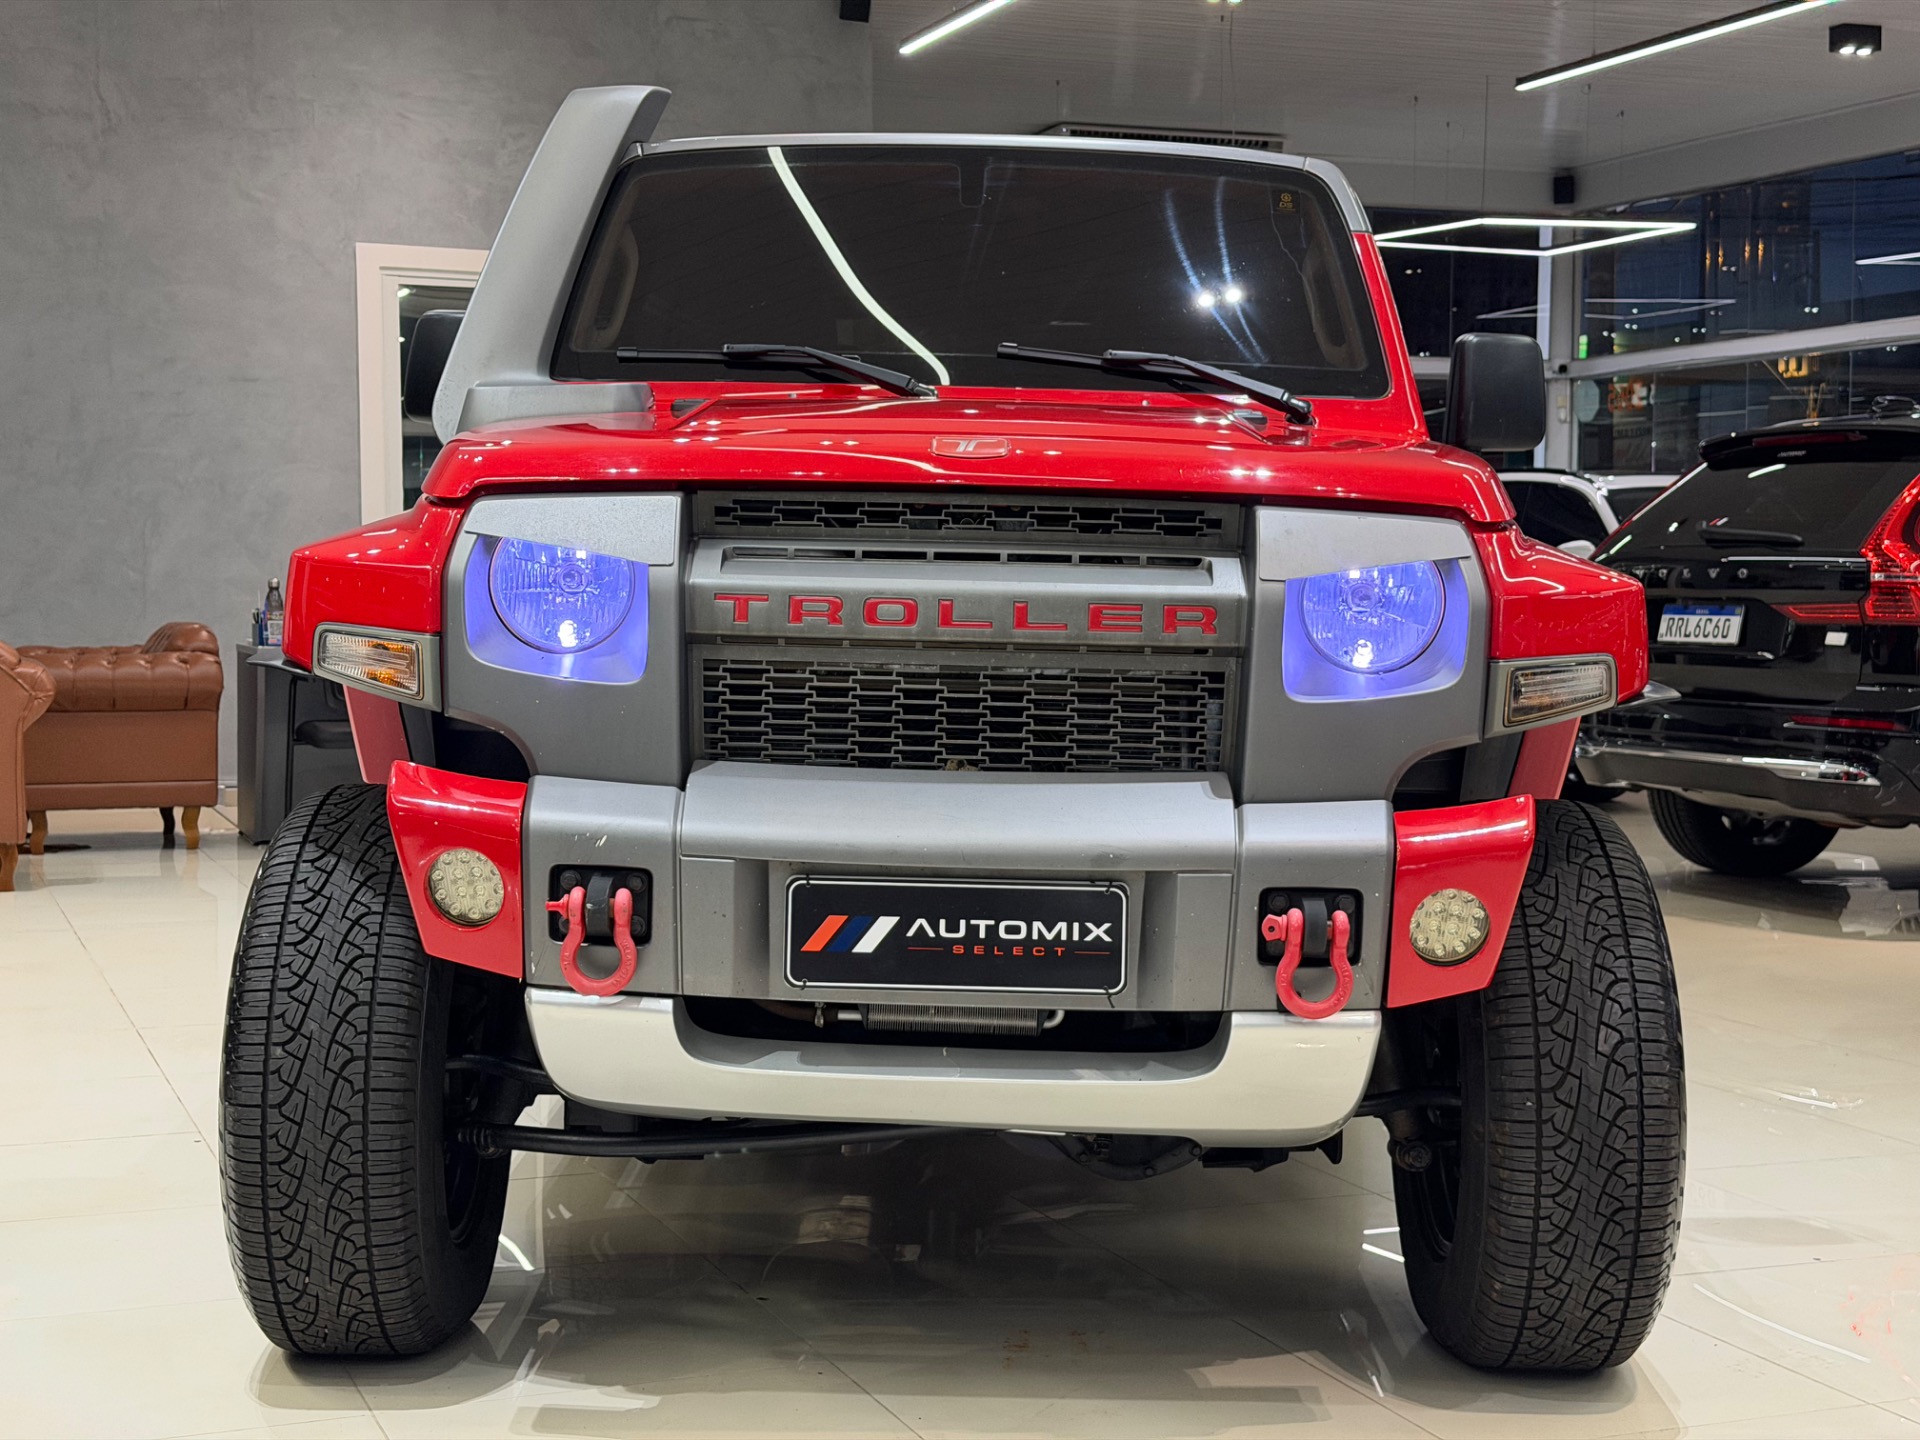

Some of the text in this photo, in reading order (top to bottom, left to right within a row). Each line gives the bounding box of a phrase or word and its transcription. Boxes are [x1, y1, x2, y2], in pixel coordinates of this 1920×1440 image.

[1632, 567, 1749, 580] VOLVO
[714, 592, 1218, 635] TROLLER
[1665, 617, 1731, 639] RRL6C60
[906, 918, 1113, 942] AUTOMIX
[952, 945, 1065, 956] SELECT
